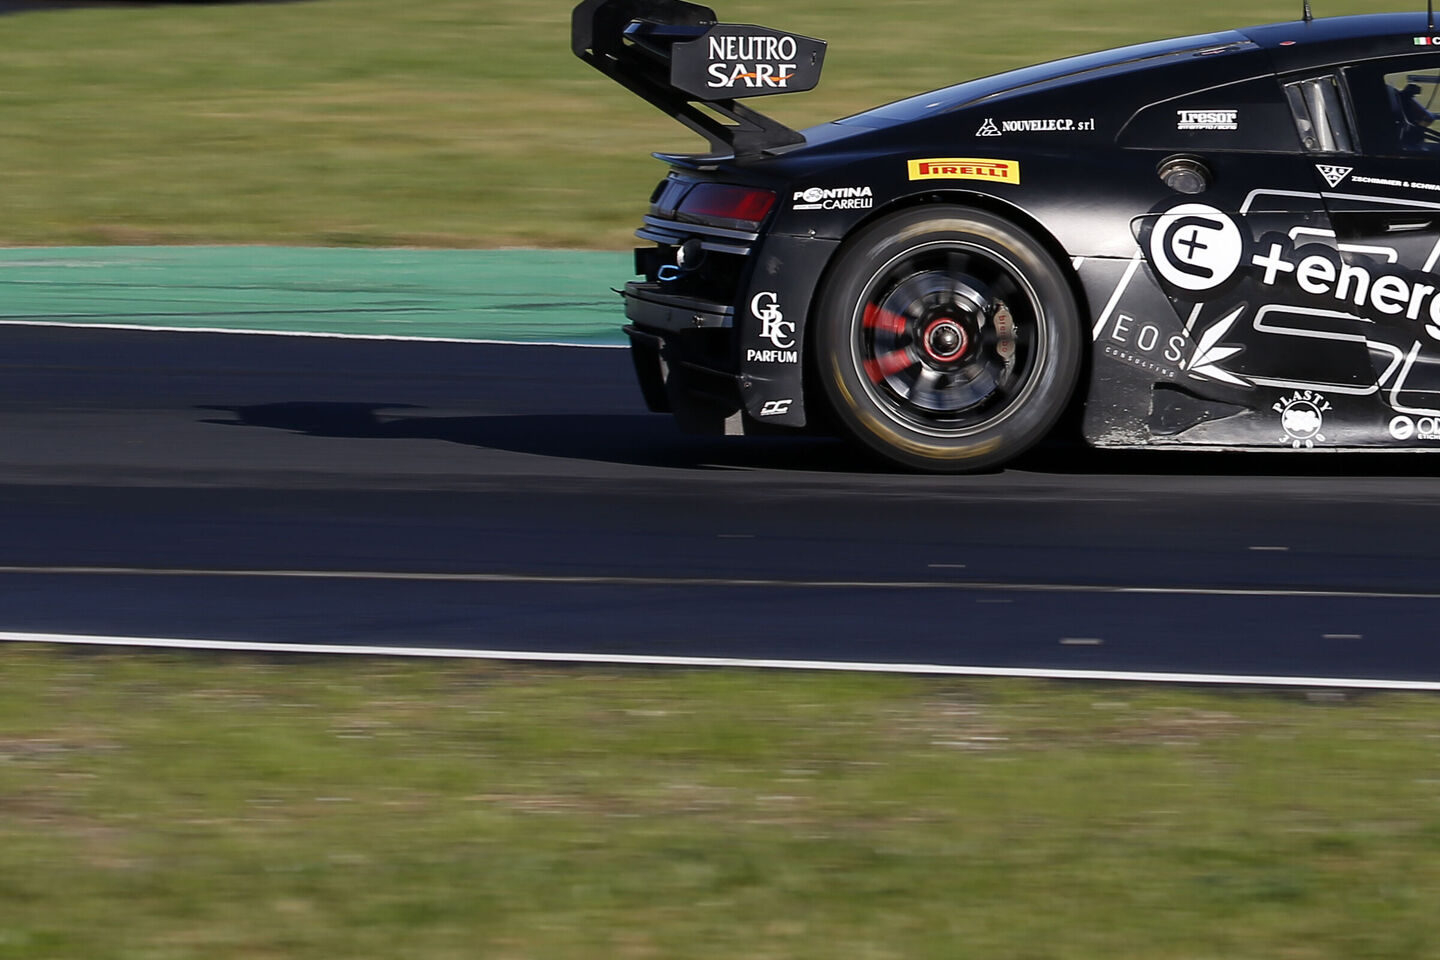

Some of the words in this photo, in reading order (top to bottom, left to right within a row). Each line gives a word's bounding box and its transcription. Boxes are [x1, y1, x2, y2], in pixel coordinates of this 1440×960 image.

[708, 36, 797, 61] NEUTRO
[707, 62, 797, 88] SARF
[1077, 118, 1095, 130] srl
[1177, 110, 1238, 123] Tresor
[919, 162, 1009, 178] PIRELLI
[1351, 176, 1402, 187] ZSCHIMMER
[822, 198, 873, 210] CARRELLI
[1111, 314, 1185, 362] EOS
[746, 349, 798, 363] PARFUM
[1105, 346, 1175, 378] CONSULTING
[1272, 390, 1333, 414] PLASTY
